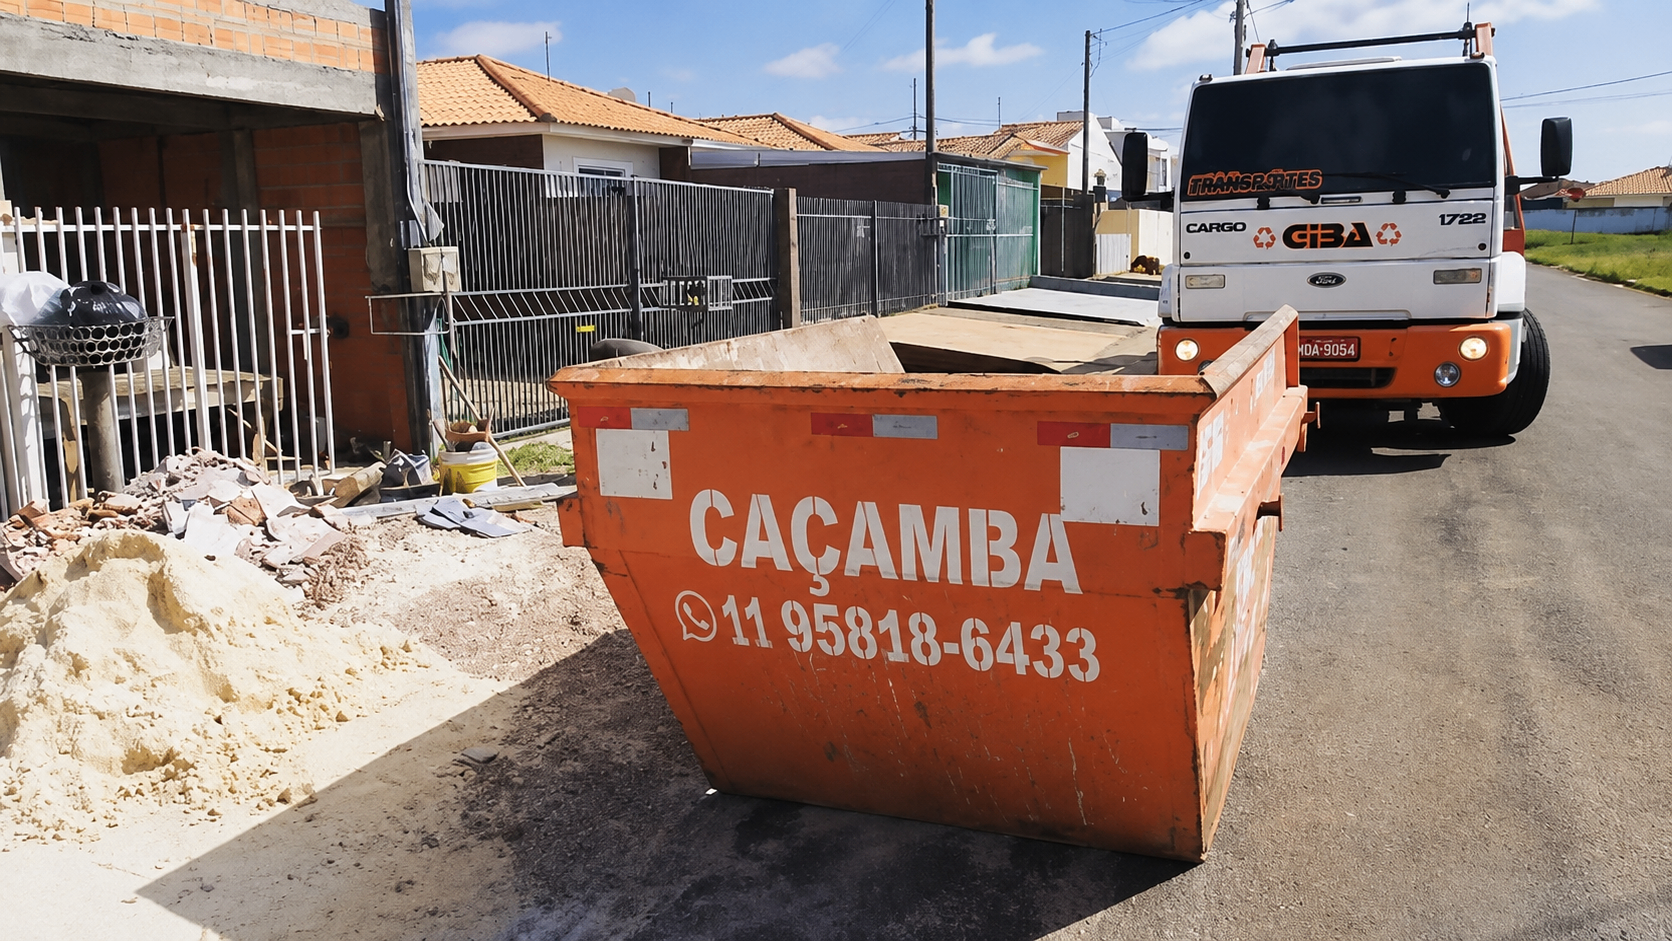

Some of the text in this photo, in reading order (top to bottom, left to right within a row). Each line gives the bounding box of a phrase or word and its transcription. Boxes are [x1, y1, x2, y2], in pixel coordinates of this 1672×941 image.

[1186, 222, 1247, 233] CARGO
[1438, 212, 1487, 226] 1722
[689, 488, 1083, 597] CAÇAMBA
[721, 594, 1100, 683] 11 95818-6433
